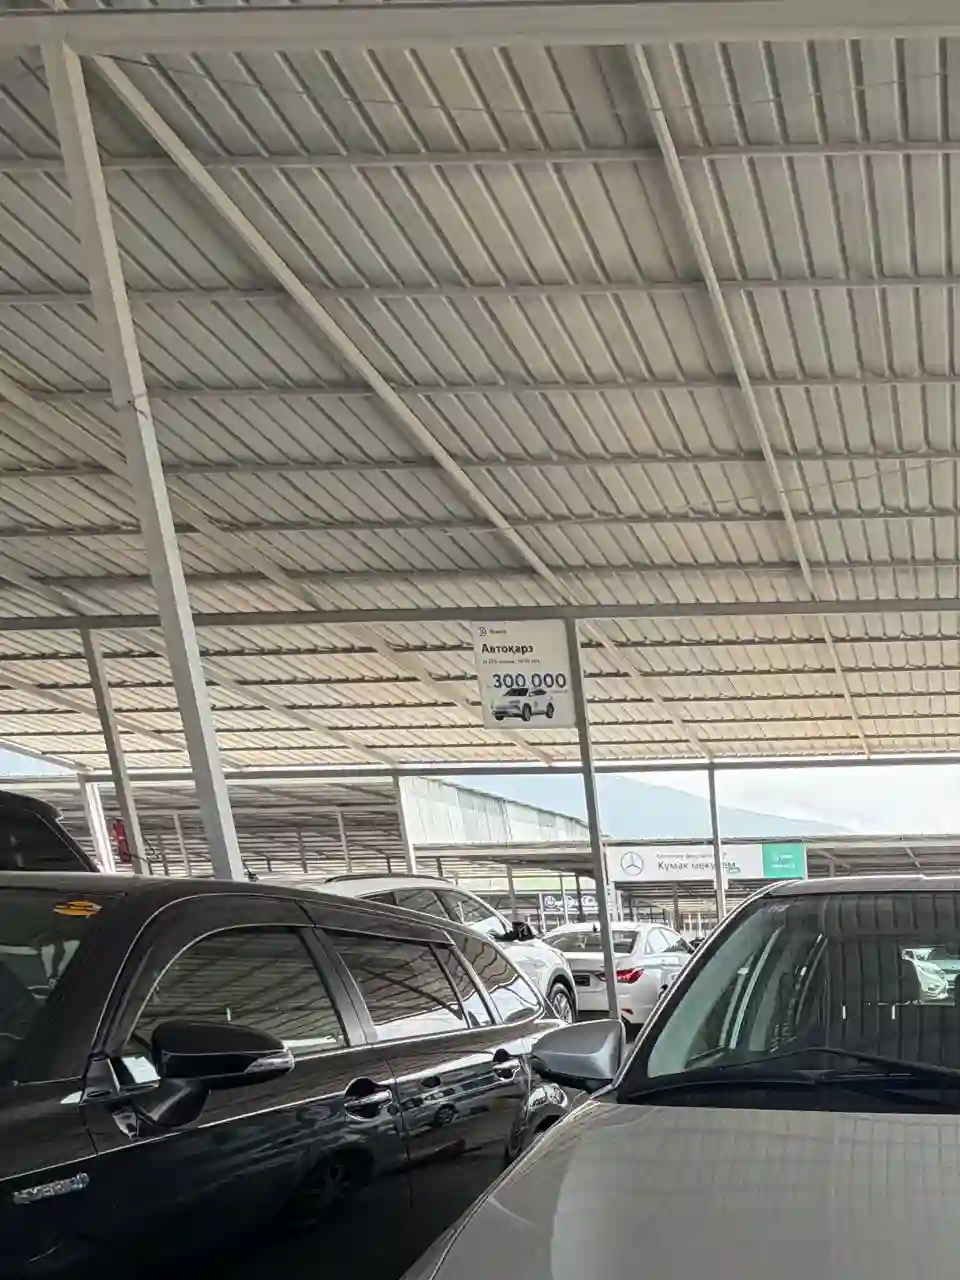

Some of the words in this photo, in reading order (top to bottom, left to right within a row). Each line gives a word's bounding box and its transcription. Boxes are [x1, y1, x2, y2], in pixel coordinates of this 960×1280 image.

[481, 643, 534, 655] Автоқарз
[493, 673, 526, 688] 300
[531, 673, 567, 688] 000
